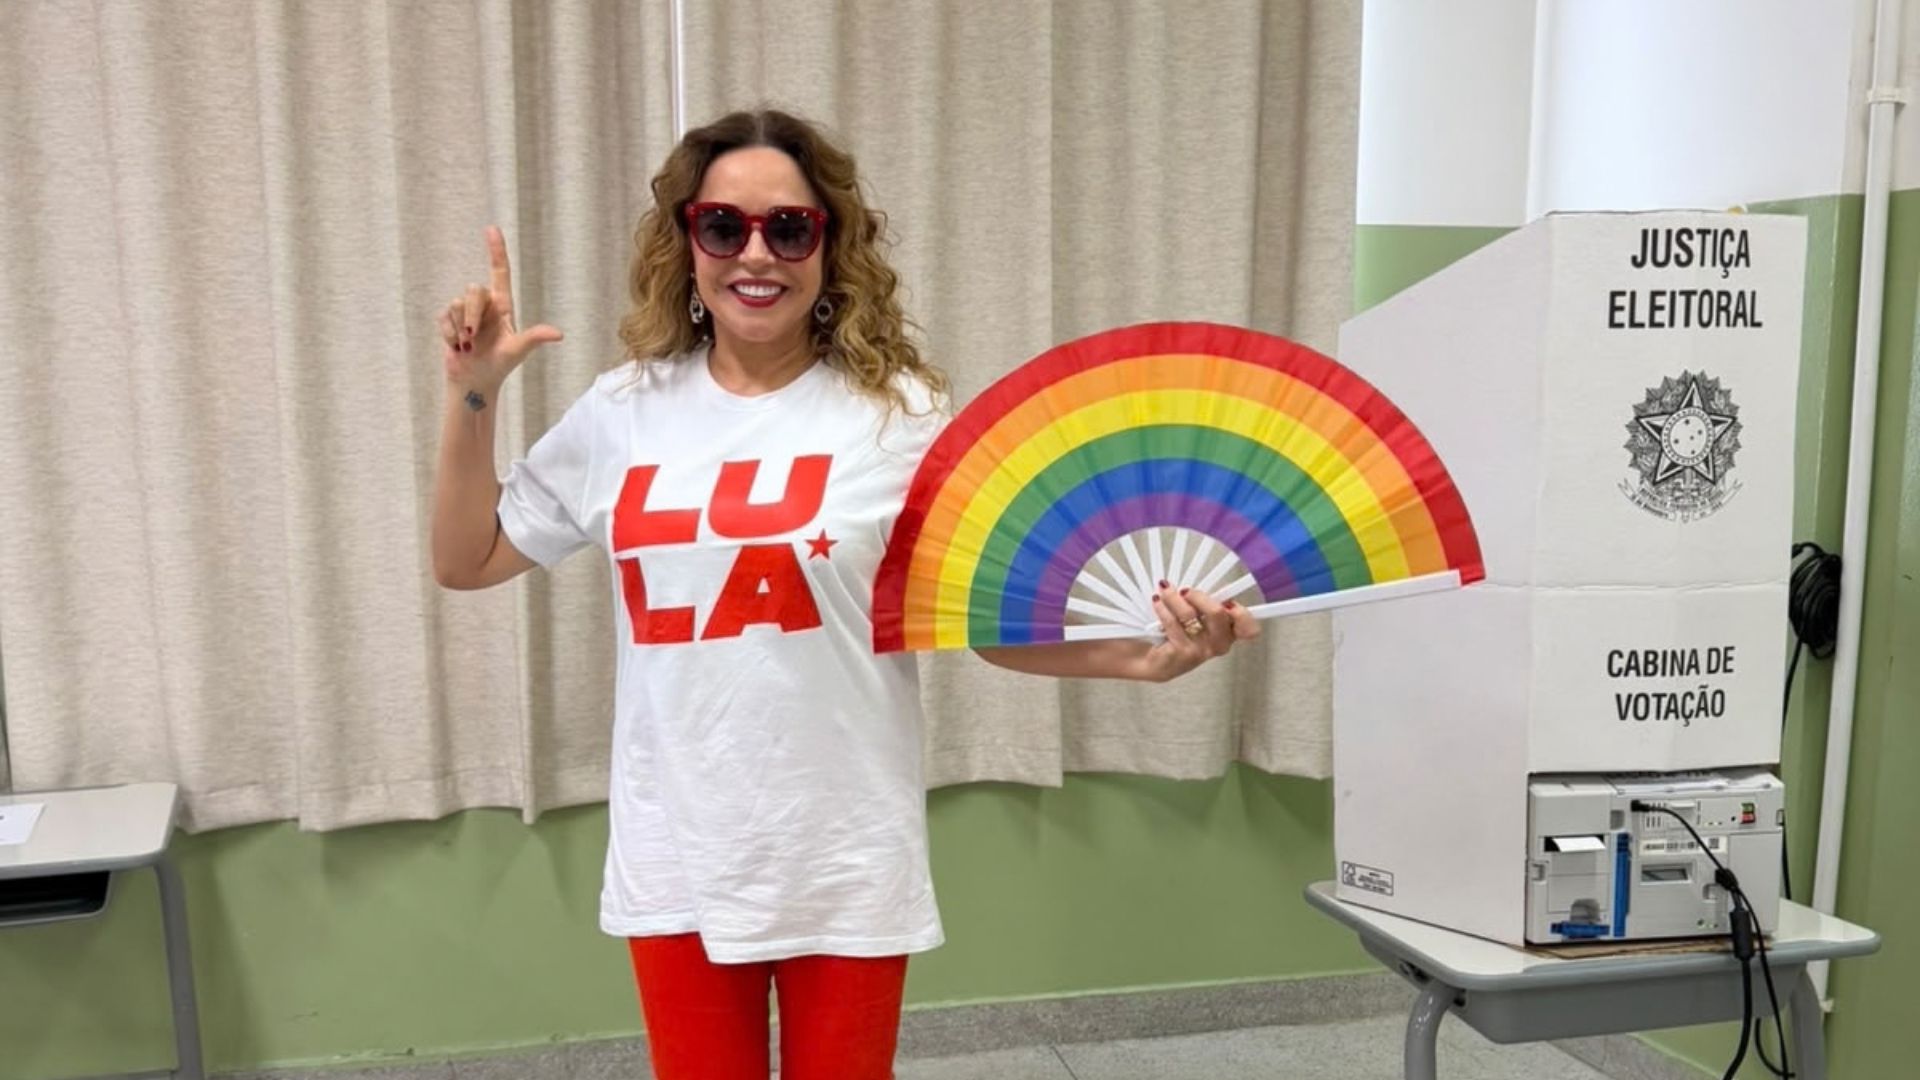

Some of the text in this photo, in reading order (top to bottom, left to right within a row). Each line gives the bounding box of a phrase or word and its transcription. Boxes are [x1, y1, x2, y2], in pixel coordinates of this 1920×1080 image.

[1631, 227, 1751, 279] JUSTIÇA
[1608, 289, 1763, 329] ELEITORAL
[612, 453, 834, 553] LU
[615, 542, 823, 644] LA
[1607, 645, 1735, 678] CABINA DE
[1615, 684, 1725, 727] VOTAÇÃO
